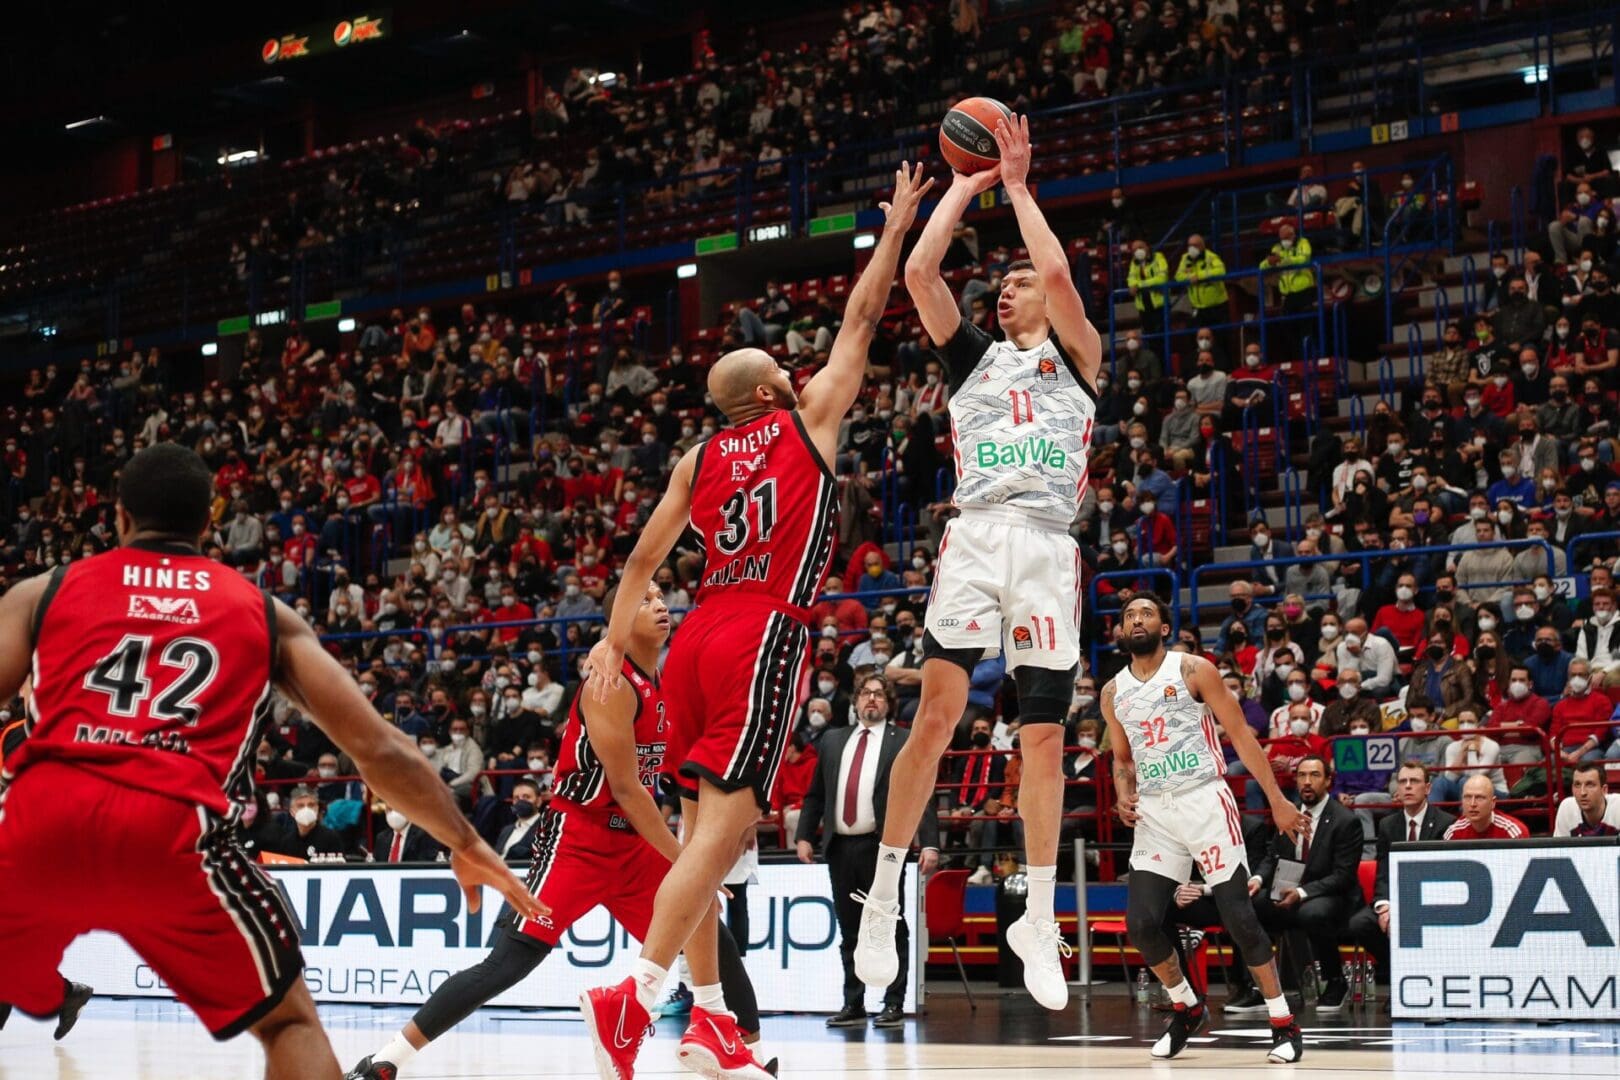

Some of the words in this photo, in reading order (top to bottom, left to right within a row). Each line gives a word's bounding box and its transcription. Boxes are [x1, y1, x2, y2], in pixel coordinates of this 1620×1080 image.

[1009, 389, 1033, 425] 11
[976, 436, 1067, 470] BayWa
[715, 477, 777, 555] 31
[123, 564, 211, 591] HINES
[1031, 615, 1056, 650] 11
[83, 633, 219, 727] 42
[1140, 716, 1169, 748] 32
[1139, 750, 1200, 780] BayWa
[1341, 744, 1360, 765] A
[1369, 743, 1393, 764] 22
[1201, 845, 1226, 876] 32
[1398, 857, 1620, 948] PA
[1400, 974, 1617, 1009] CERAM
